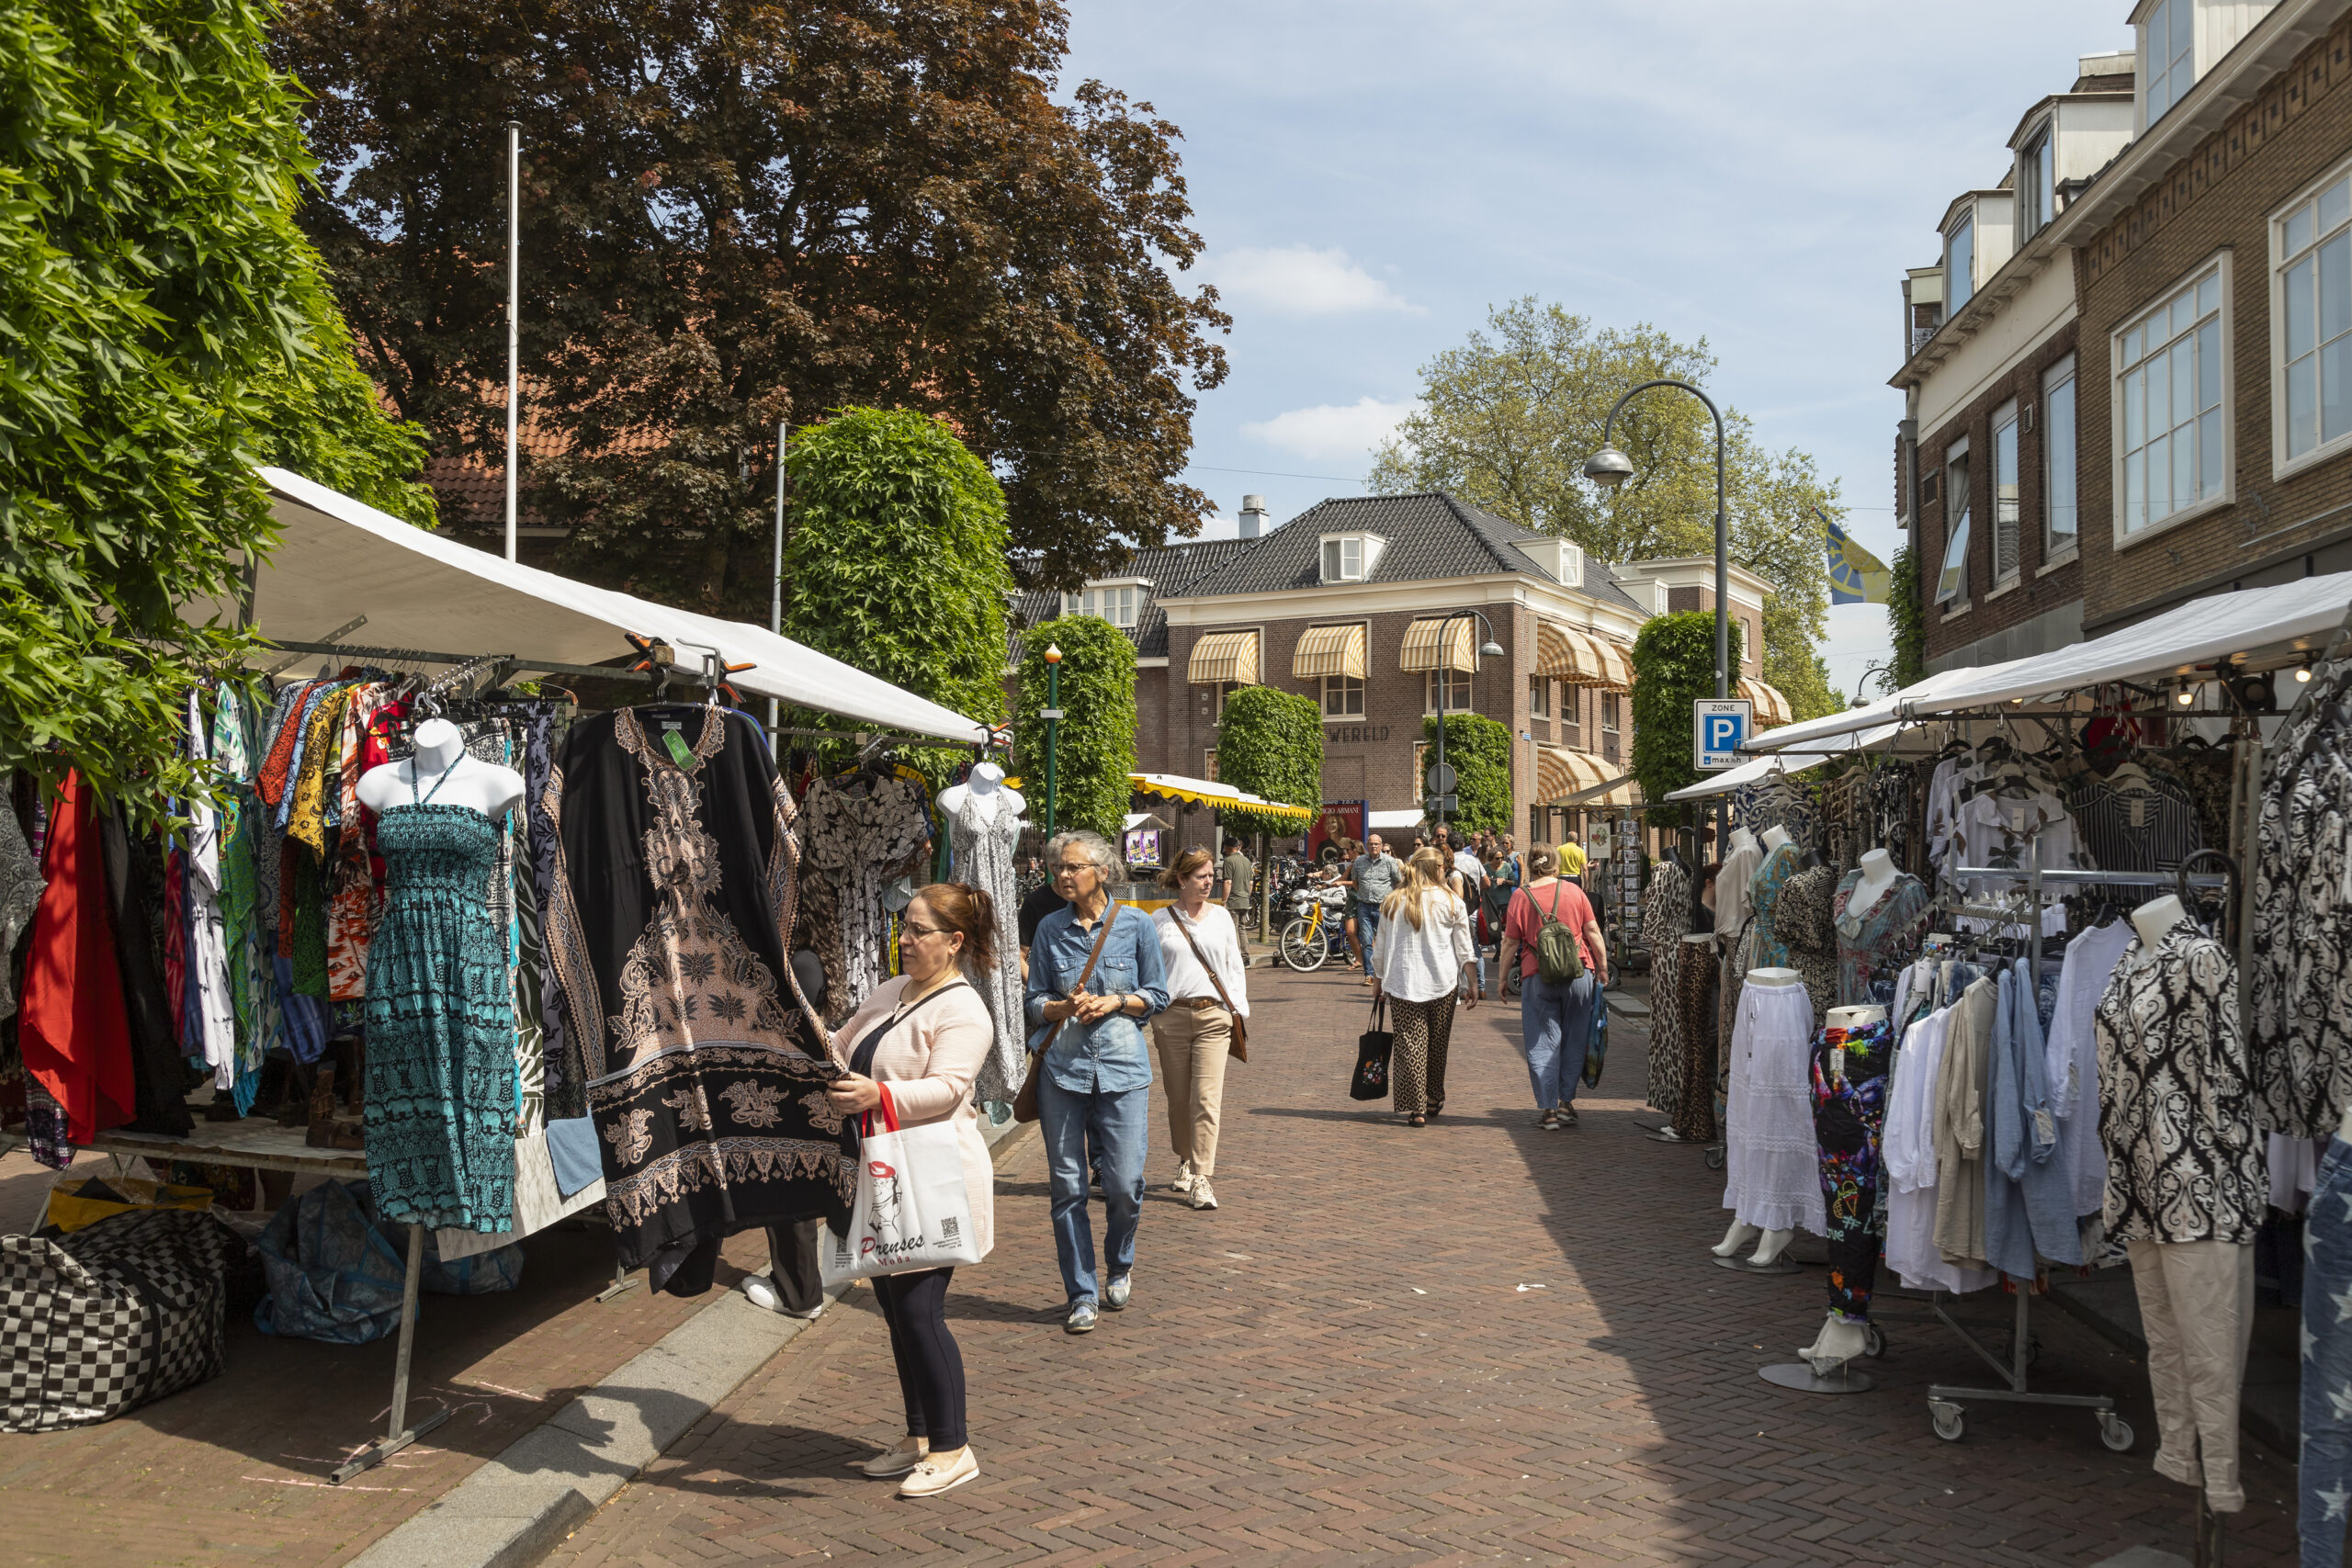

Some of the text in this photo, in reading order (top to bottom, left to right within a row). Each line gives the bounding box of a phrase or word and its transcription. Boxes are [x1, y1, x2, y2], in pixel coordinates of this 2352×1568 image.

[1713, 719, 1734, 748] P
[861, 1235, 924, 1258] Prenses
[878, 1256, 910, 1266] Moda
